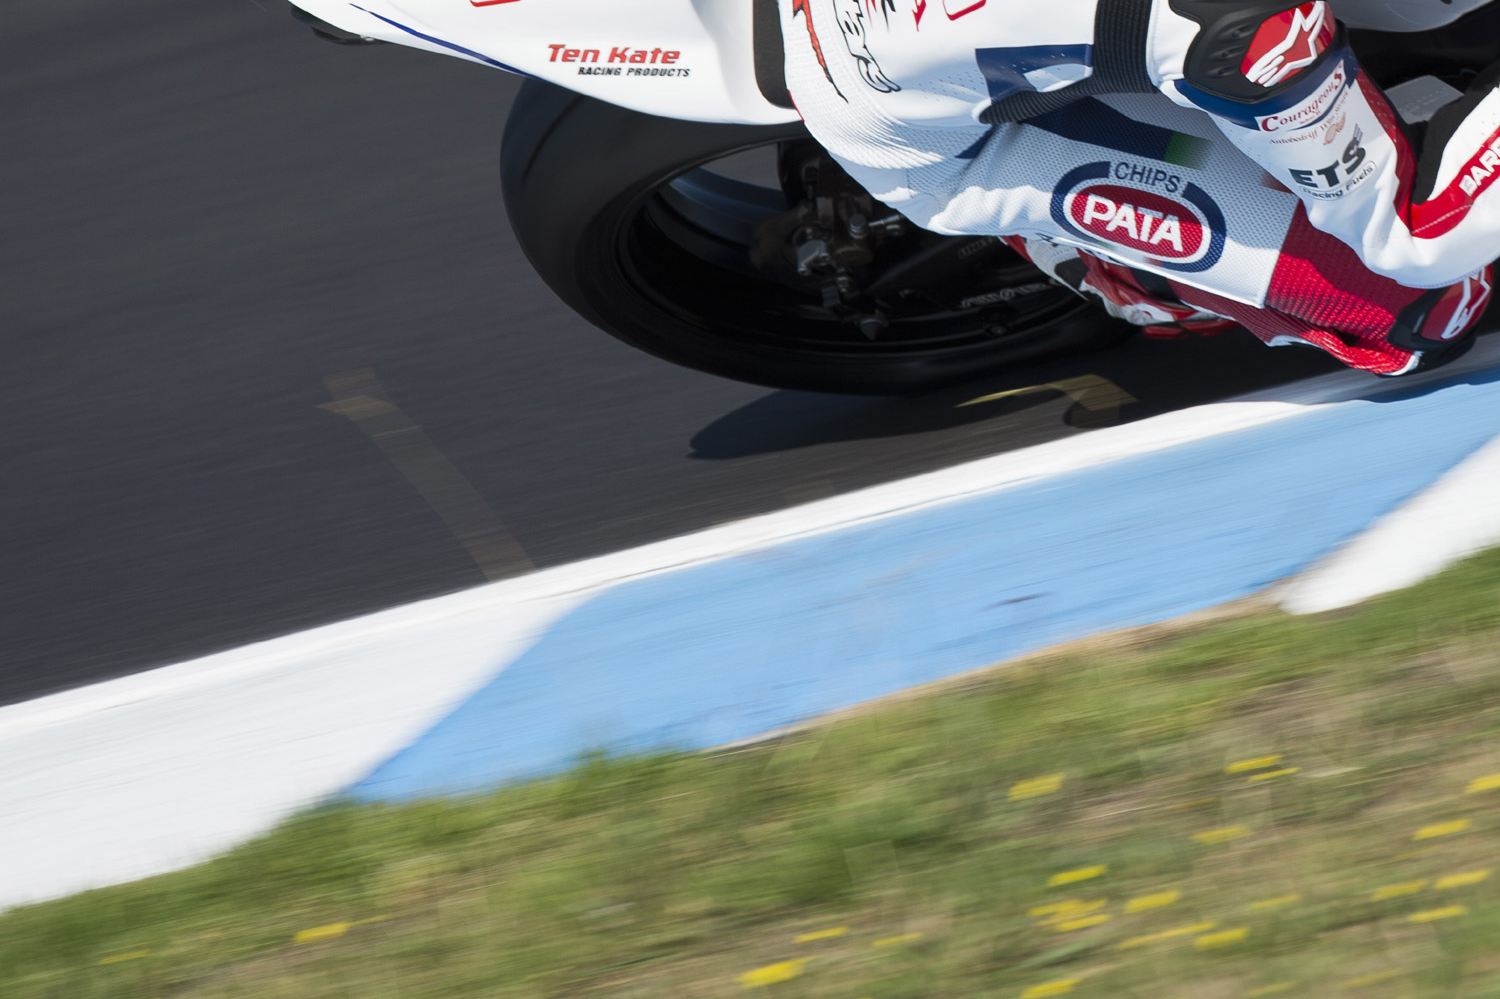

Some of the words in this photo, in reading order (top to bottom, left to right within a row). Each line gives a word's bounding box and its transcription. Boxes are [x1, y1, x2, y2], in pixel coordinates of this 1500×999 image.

[548, 44, 601, 64] Ten
[609, 46, 680, 65] Kate
[578, 66, 621, 77] RACING
[627, 67, 691, 78] PRODUCTS
[1288, 134, 1367, 188] ETS
[1115, 162, 1180, 194] CHIPS
[1083, 195, 1185, 253] PATA
